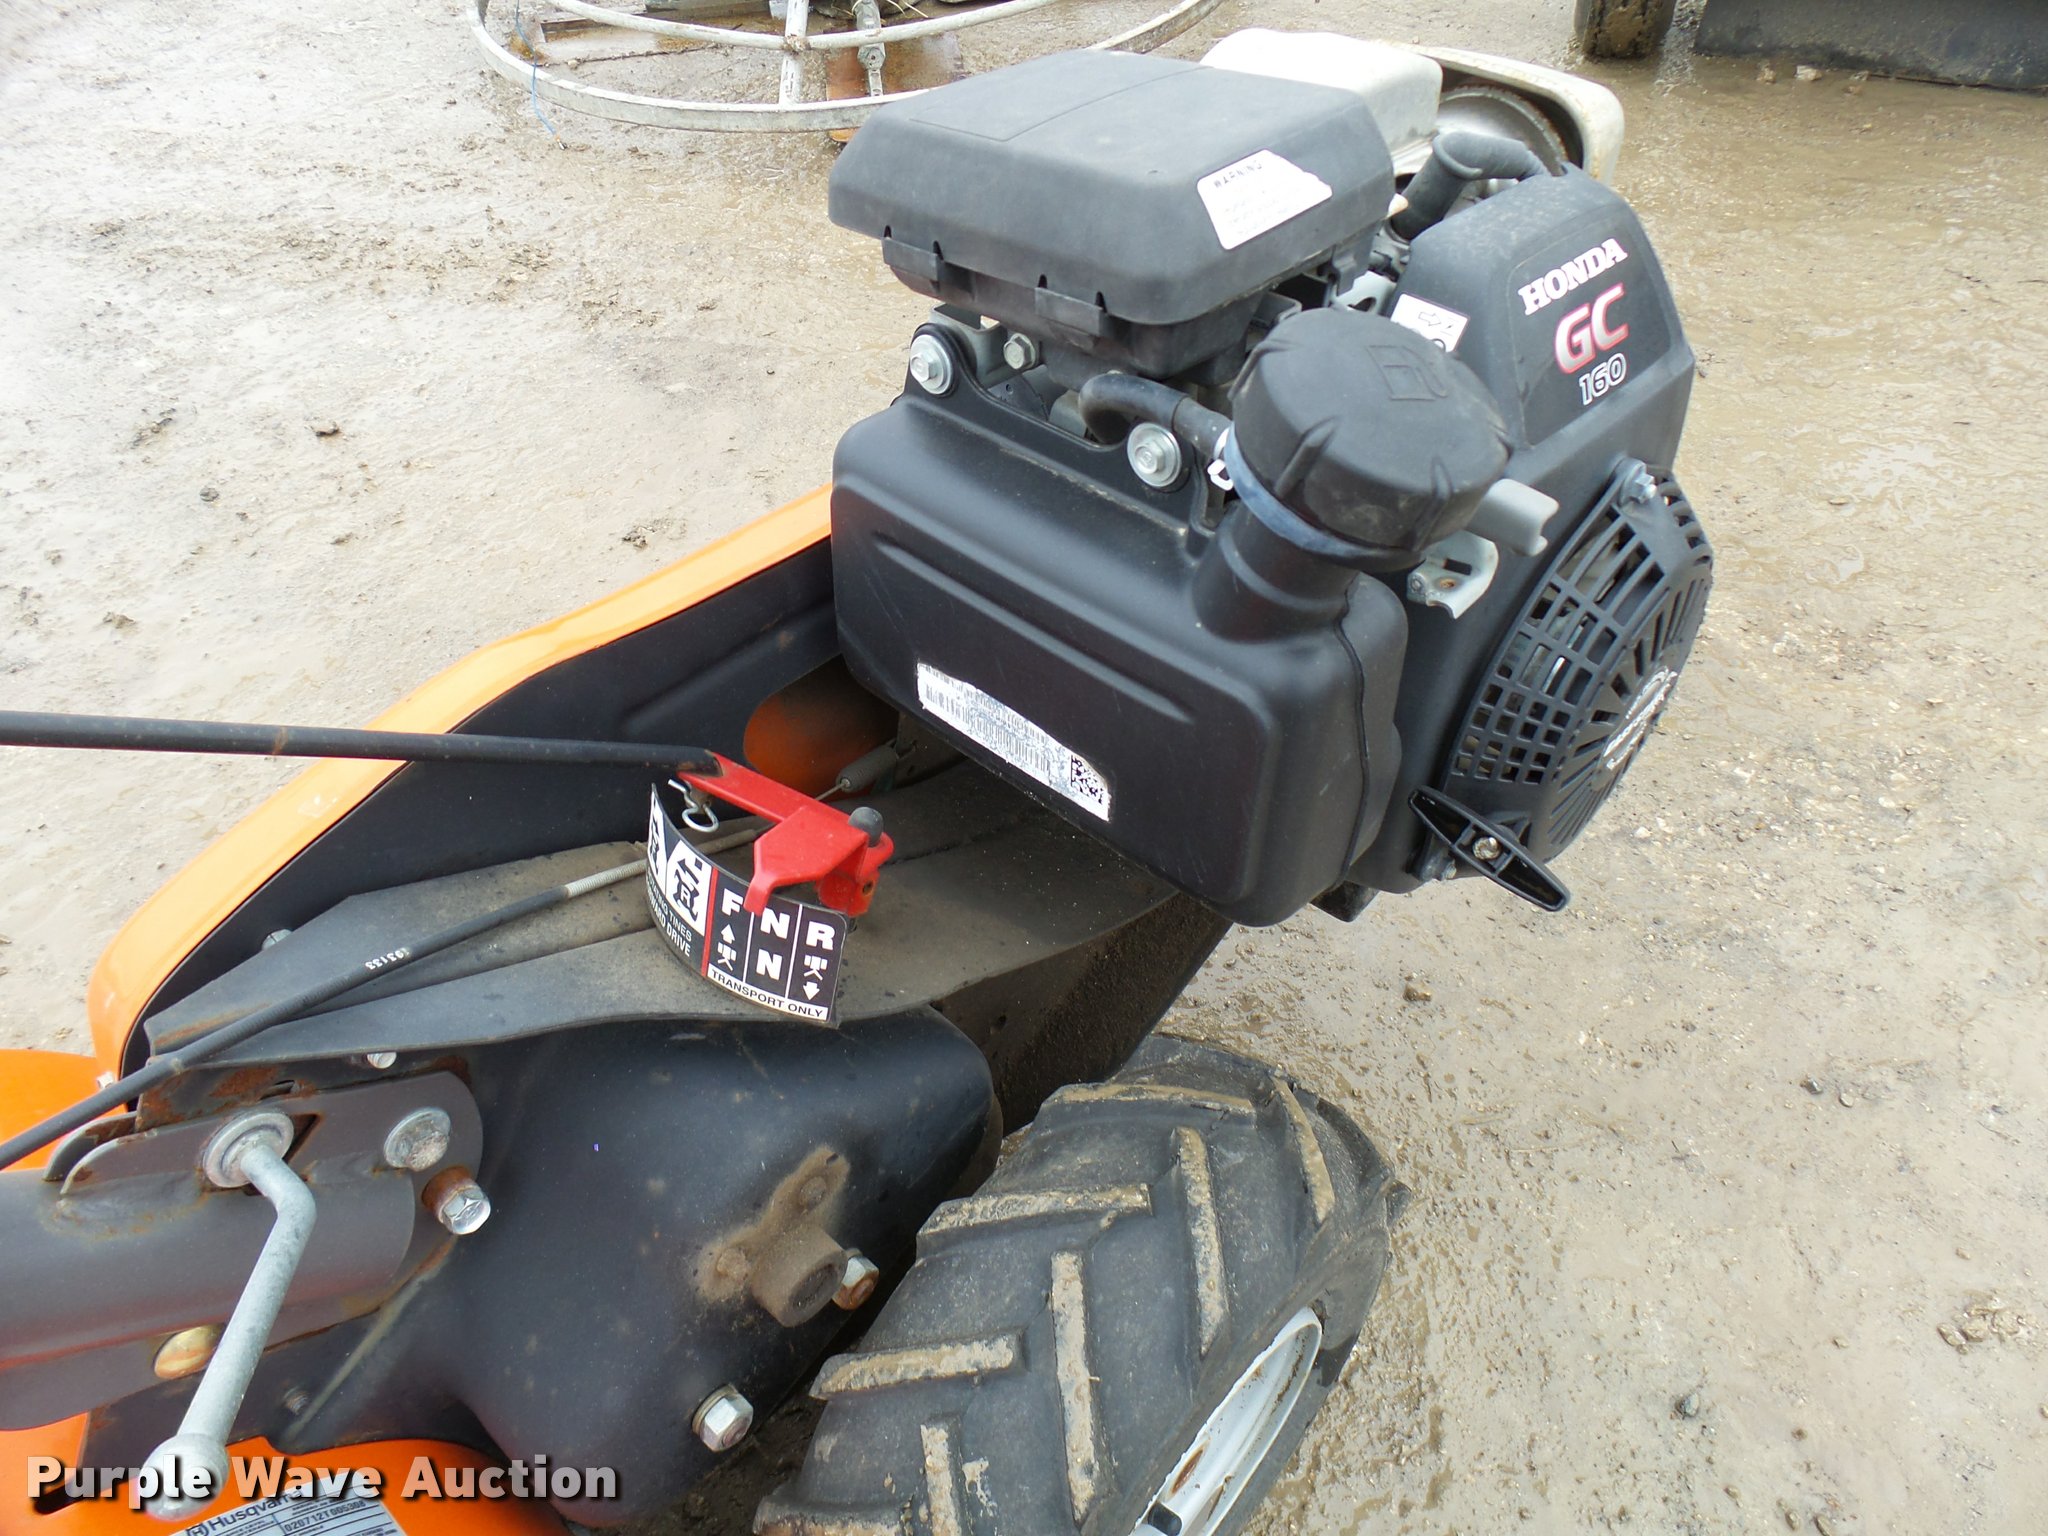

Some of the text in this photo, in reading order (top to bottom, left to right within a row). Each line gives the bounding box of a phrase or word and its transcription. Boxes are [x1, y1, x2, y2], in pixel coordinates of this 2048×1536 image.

[1517, 238, 1628, 316] HONDA
[1555, 282, 1629, 374] GC
[1578, 353, 1627, 405] 160
[667, 922, 691, 958] DRIVE
[669, 910, 692, 943] TINES
[721, 888, 834, 951] F N R
[756, 949, 783, 981] N
[712, 968, 824, 1019] TRANSPORT ONLY
